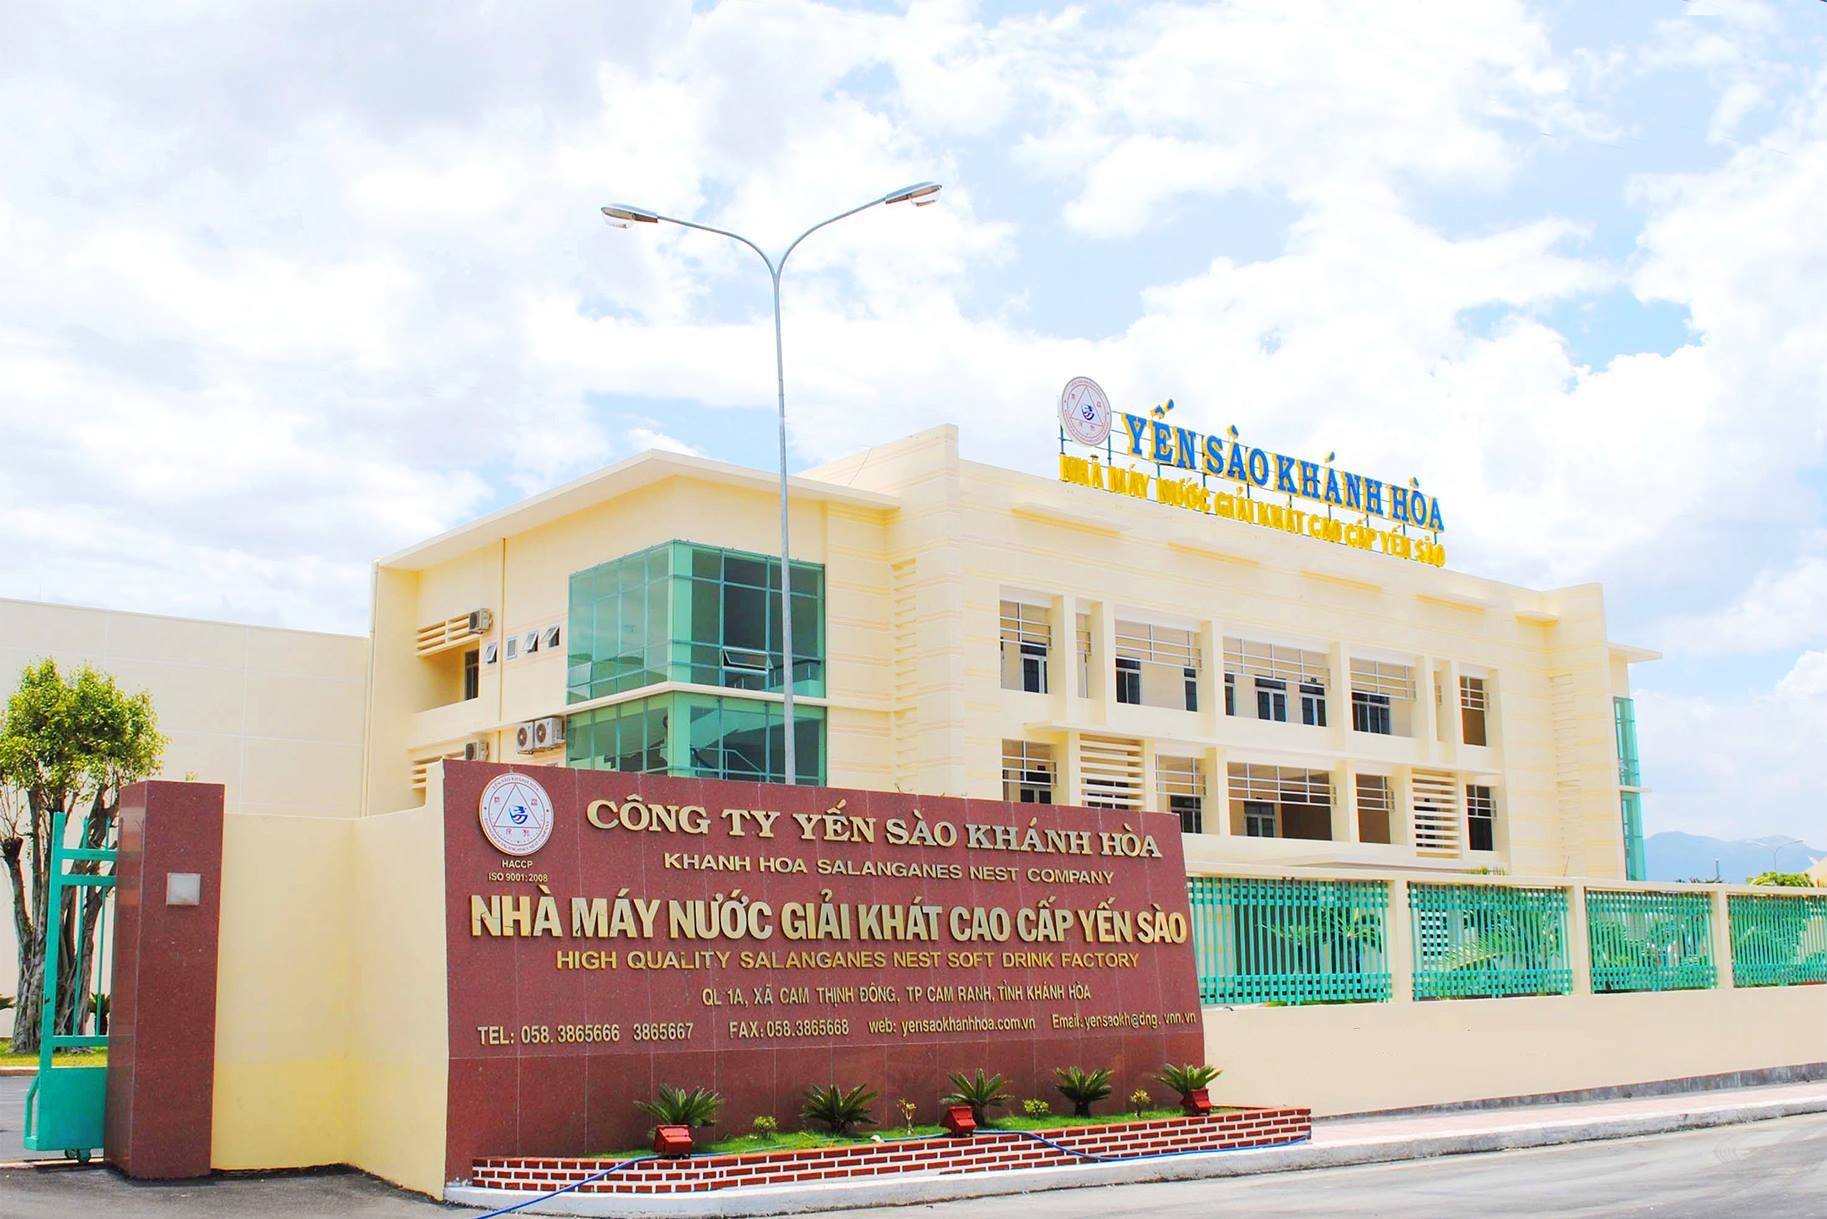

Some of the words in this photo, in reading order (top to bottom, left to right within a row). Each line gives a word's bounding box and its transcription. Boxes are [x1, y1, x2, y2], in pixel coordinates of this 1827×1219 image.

[1121, 399, 1197, 470] YẾN
[1201, 424, 1269, 487] SÀO
[1272, 451, 1385, 518] KHÁNH
[1387, 476, 1445, 533] HÒA
[586, 794, 711, 834] CÔNG
[721, 808, 780, 838] TY
[792, 799, 876, 843] YẾN
[885, 808, 957, 848] SÀO
[965, 817, 1092, 856] KHÁNH
[1099, 823, 1163, 859] HÒA
[488, 872, 504, 881] ISO
[505, 873, 548, 882] 9001:2008
[502, 859, 533, 869] HACCP
[664, 852, 751, 872] KHANH
[759, 857, 808, 874] HOA
[816, 859, 962, 879] SALANGANES
[970, 866, 1019, 882] NEST
[1027, 868, 1115, 885] COMPANY
[470, 885, 563, 938] NHÀ
[571, 888, 660, 938] MÁY
[669, 889, 773, 940] NƯỚC
[780, 889, 851, 941] GIẢI
[858, 896, 942, 942] KHÁT
[949, 906, 1011, 943] CAO
[1016, 895, 1074, 943] CẤP
[1078, 897, 1132, 944] YẾN
[1136, 903, 1187, 945] SÀO
[556, 950, 617, 970] HIGH
[627, 951, 731, 970] QUALITY
[739, 951, 887, 969] SALANGANES
[893, 951, 942, 968] NEST
[947, 952, 994, 968] SOFT
[1002, 952, 1054, 968] DRINK
[1061, 952, 1140, 969] FACTORY
[702, 987, 722, 1006] QL
[727, 987, 749, 1007] 1A,
[754, 984, 774, 1005] XÃ
[779, 987, 810, 1005] CAM
[816, 985, 854, 1007] THỊNH
[906, 986, 923, 1002] TP
[927, 986, 954, 1002] CAM
[957, 985, 995, 1003] RANH,
[1026, 981, 1065, 1001] KHÁNH
[1068, 980, 1092, 1000] HÒA
[477, 1025, 515, 1045] TEL:
[633, 1022, 694, 1041] 3865667
[869, 1017, 896, 1033] web:
[901, 1014, 1036, 1037] yensaokhanhhoa.com.vn
